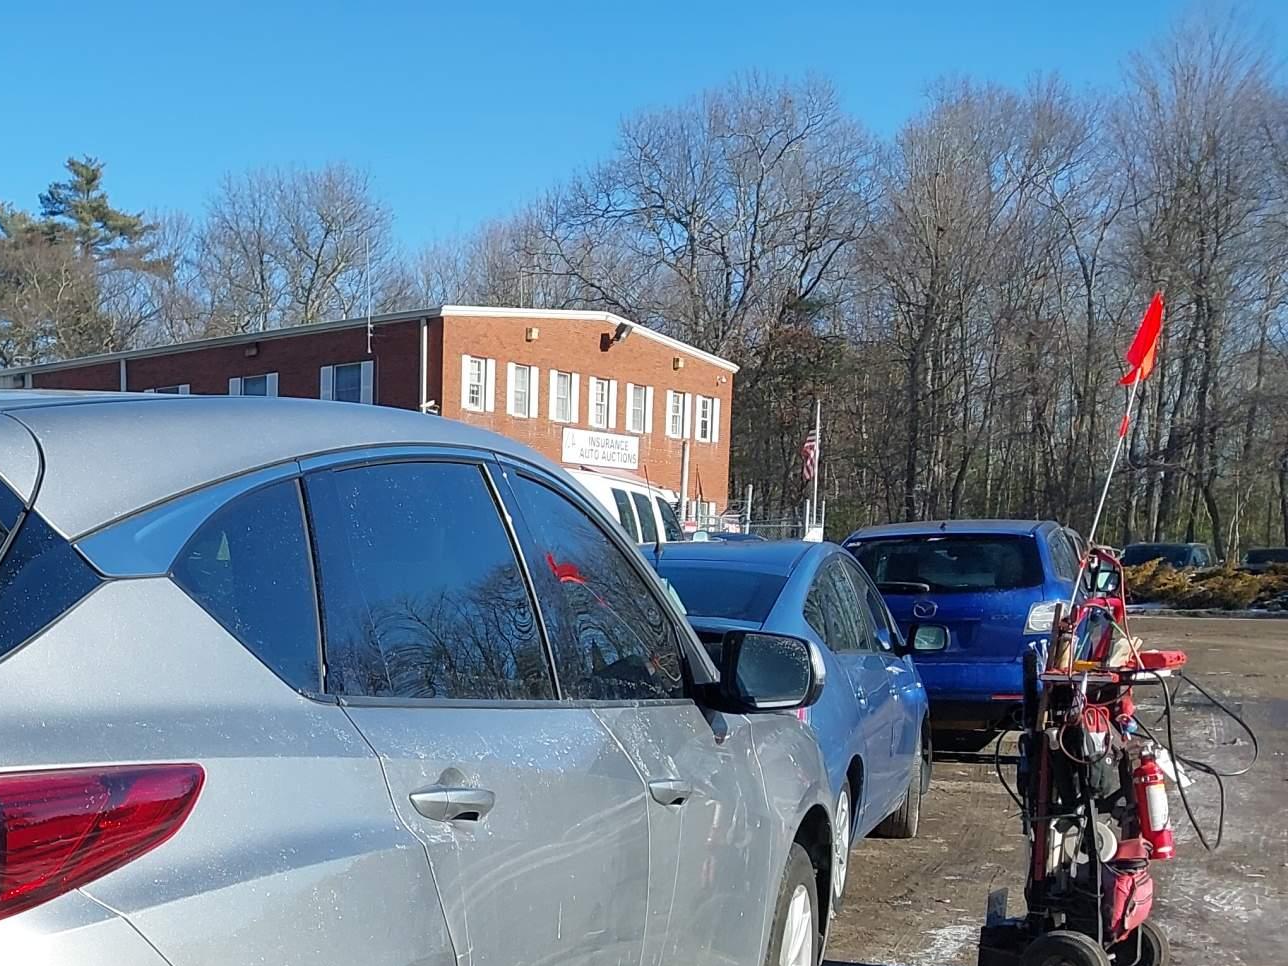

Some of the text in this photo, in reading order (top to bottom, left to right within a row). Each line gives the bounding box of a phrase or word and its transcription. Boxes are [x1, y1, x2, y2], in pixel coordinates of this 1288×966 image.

[588, 436, 629, 451] INSURANCE
[579, 447, 637, 464] AUTO AUCTIONS
